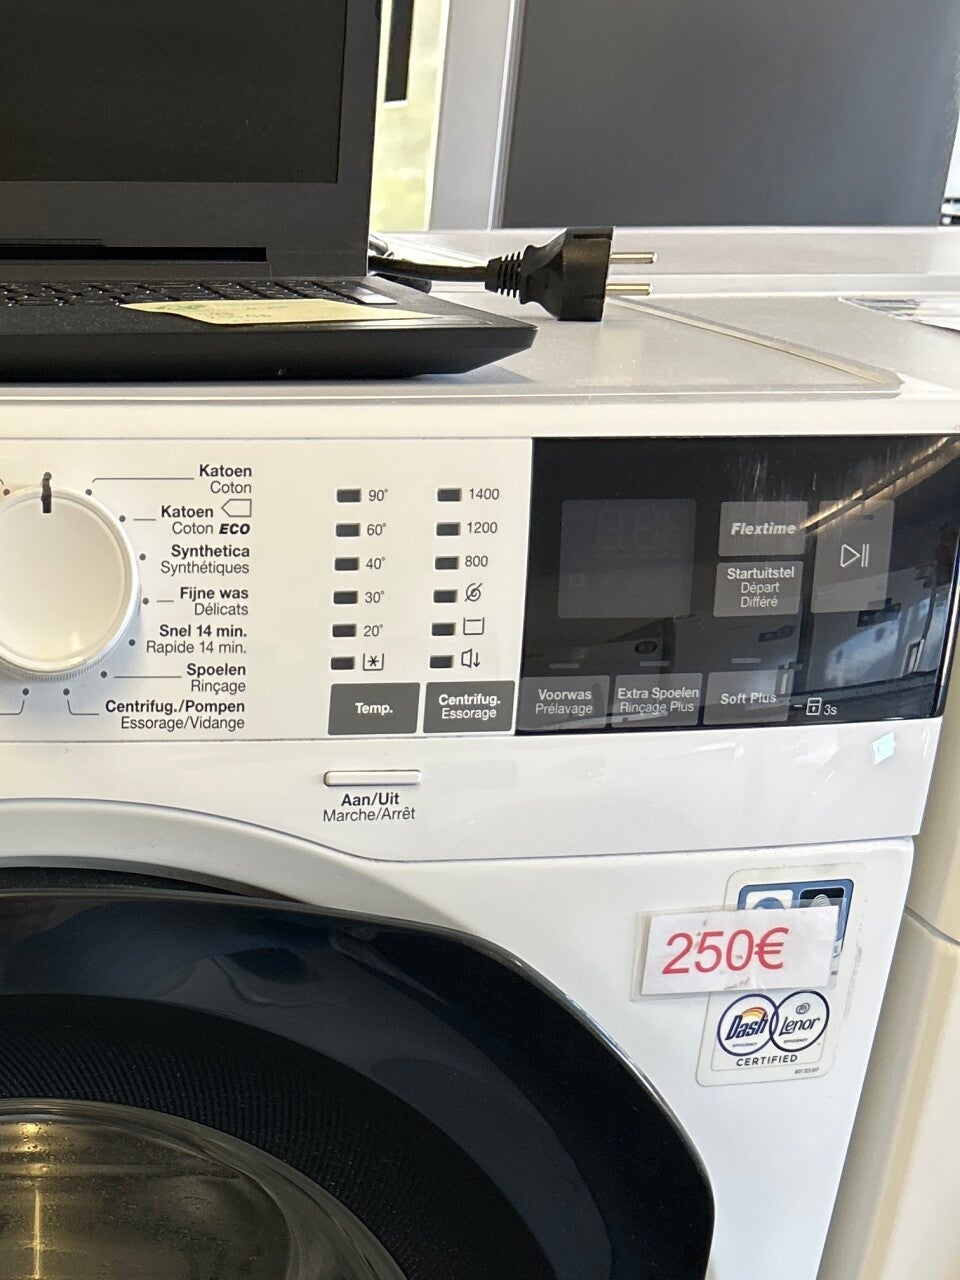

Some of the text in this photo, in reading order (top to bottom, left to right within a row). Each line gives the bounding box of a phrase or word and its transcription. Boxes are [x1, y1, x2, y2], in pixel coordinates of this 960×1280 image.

[199, 464, 252, 477] Katoen
[210, 481, 252, 494] Coton
[469, 489, 499, 500] 1400
[161, 505, 214, 518] Katoen
[172, 522, 250, 535] Coton ECO
[467, 522, 498, 533] 1200
[731, 523, 796, 535] Flextime
[171, 545, 250, 560] Synthetica
[465, 556, 488, 567] 800
[160, 561, 250, 577] Synthétiques
[727, 567, 795, 579] Startuitstel
[180, 587, 249, 602] Fijne was
[741, 582, 779, 596] Départ
[740, 595, 777, 608] Différé
[194, 602, 249, 616] Délicats
[159, 624, 247, 637] Snel 14 min.
[146, 641, 247, 656] Rapide 14 min.
[187, 663, 246, 679] Spoelen
[191, 680, 246, 696] Rinçage
[539, 688, 592, 700] Voorwas
[618, 687, 699, 700] Extra Spoelen
[439, 694, 501, 706] Centrifug.
[720, 692, 776, 704] Soft Plus
[105, 700, 245, 717] Centrifug./Pompen
[355, 703, 393, 714] Temp.
[442, 708, 496, 720] Essorage
[535, 702, 593, 716] Prélavage
[620, 701, 694, 715] Rinçage Plus
[824, 704, 837, 715] 3s
[121, 716, 244, 732] Essorage/Vidange
[341, 792, 400, 806] Aan/Uit
[323, 807, 415, 822] Marche/Arrêt
[661, 927, 789, 975] 250€
[725, 1011, 769, 1040] Dash
[779, 1017, 820, 1036] Lenor
[736, 1055, 798, 1066] CERTIFIED
